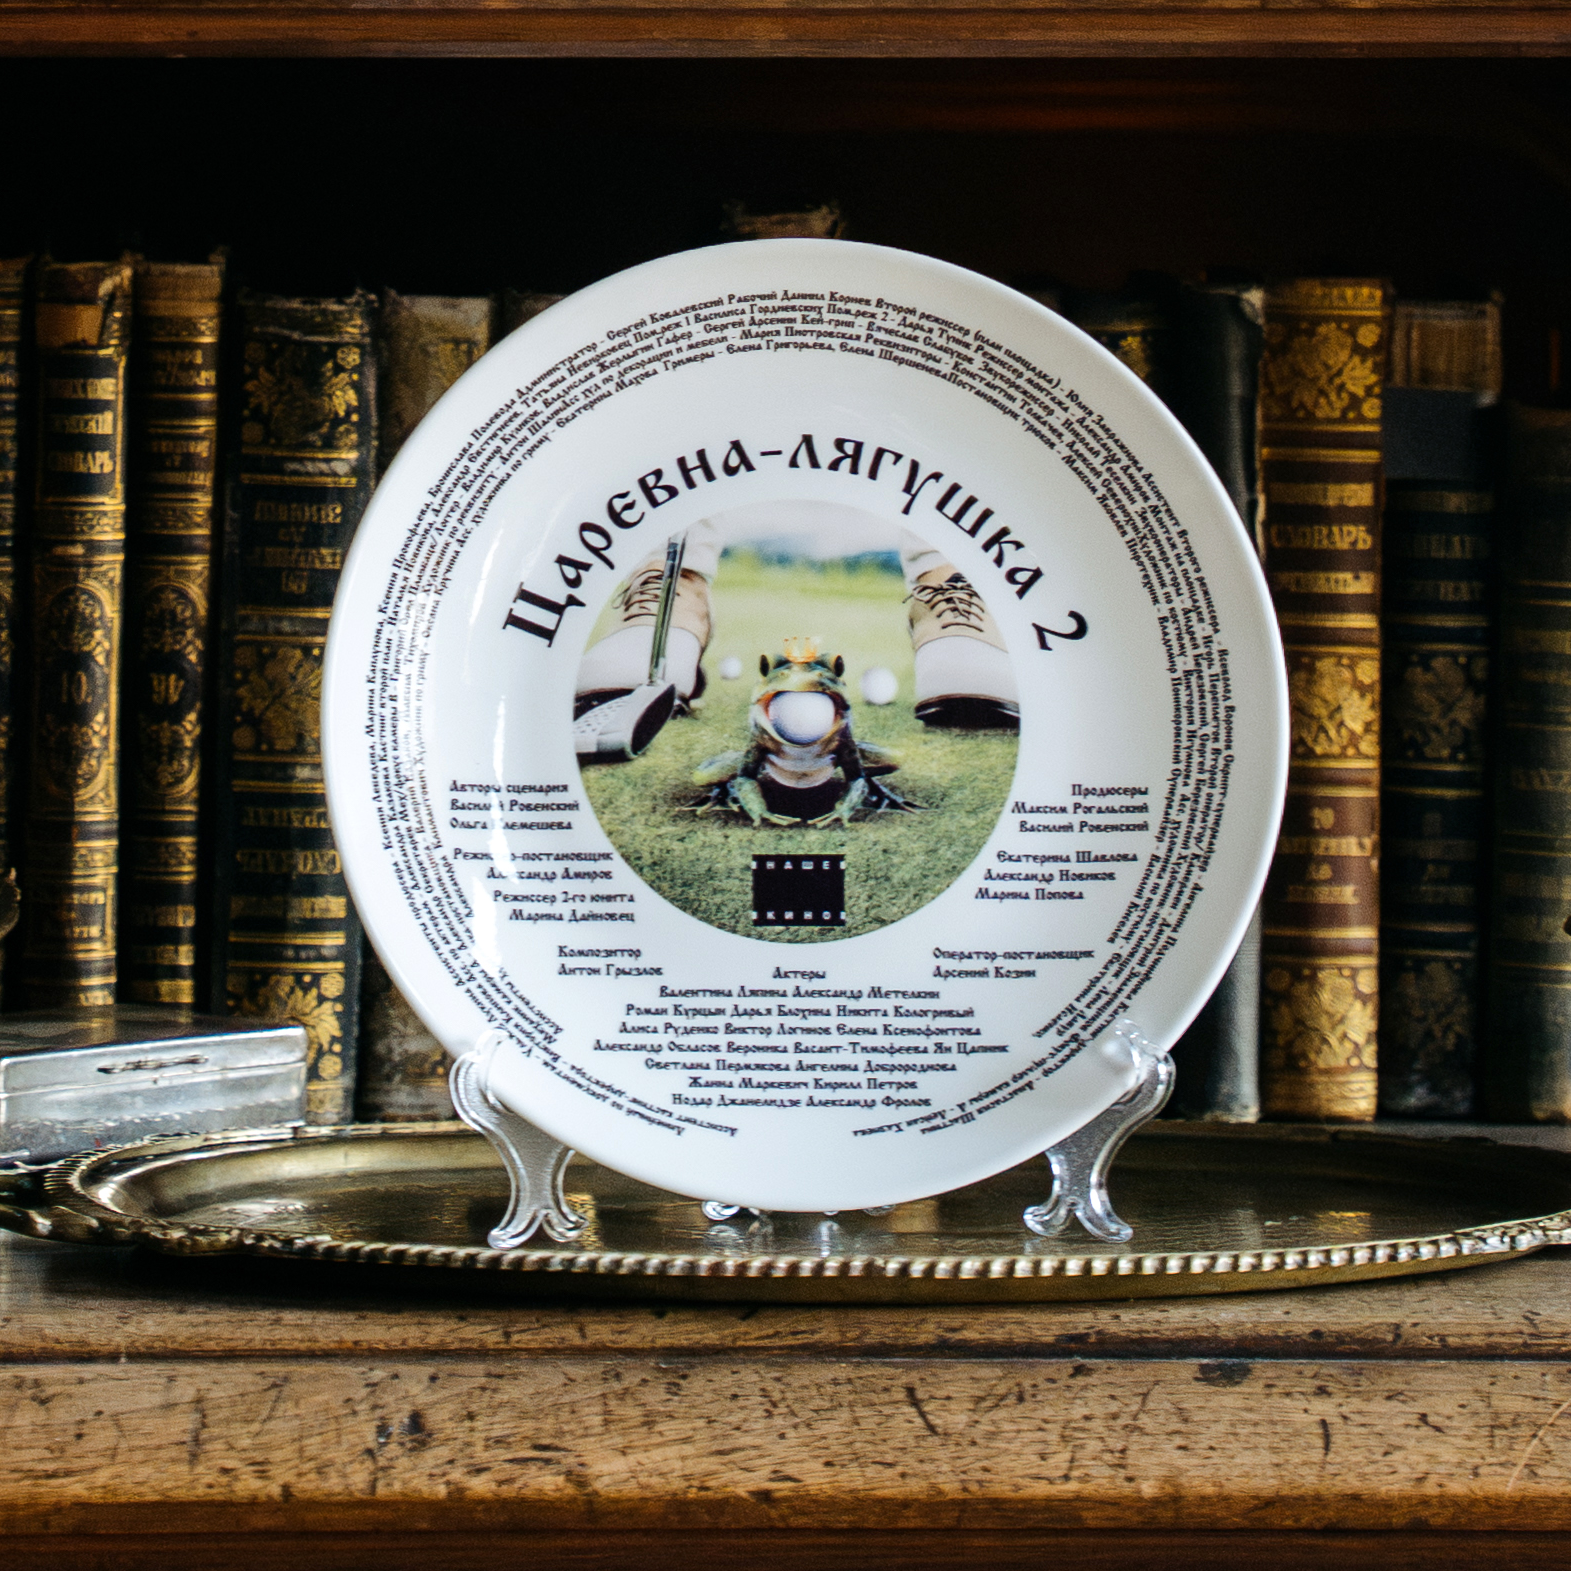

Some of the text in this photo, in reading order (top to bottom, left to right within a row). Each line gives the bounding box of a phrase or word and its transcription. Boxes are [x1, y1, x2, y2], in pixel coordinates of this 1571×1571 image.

[502, 434, 1089, 651] Царевна-лягушка 2
[507, 784, 569, 795] сценария
[1072, 784, 1148, 798] Продюсеры
[509, 799, 579, 811] Ровенский
[1011, 801, 1148, 814] Максим Рогальский
[450, 818, 572, 829] Ольга лемешева
[1019, 821, 1149, 832] Василий Ровенский
[997, 851, 1070, 866] Екатерина
[561, 867, 612, 881] Амиров
[985, 869, 1115, 884] Александр Новиков
[494, 890, 634, 906] Режиссер 2-го юнита
[975, 888, 1084, 903] Марина Попова
[509, 909, 563, 924] Марина
[558, 946, 641, 960] Композитор
[933, 947, 1095, 962] Оператор-постановщик
[558, 964, 663, 979] Антон Грызлов
[773, 967, 826, 982] Актеры
[933, 965, 1036, 980] Арсений Козин
[659, 985, 940, 1001] Валентина Ляпина Александр Метелкин
[626, 1004, 974, 1020] Роман Курцын Дарья Блохина Никита Кологривый
[619, 1022, 981, 1039] Алиса Руденко Виктор Логинов Елена Ксенофонтова
[594, 1040, 662, 1055] Александр
[668, 1041, 721, 1052] Обласов
[726, 1041, 788, 1056] Вероника
[933, 1042, 952, 1053] Ян
[957, 1042, 1009, 1055] Цапник
[645, 1058, 710, 1070] Светлана
[716, 1059, 790, 1073] Пермякова
[796, 1060, 858, 1072] Ангелина
[688, 1076, 917, 1092] Жанна Маркевич Кирилл Петров
[672, 1094, 931, 1109] Нодар Джанелидзе Александр Фролов
